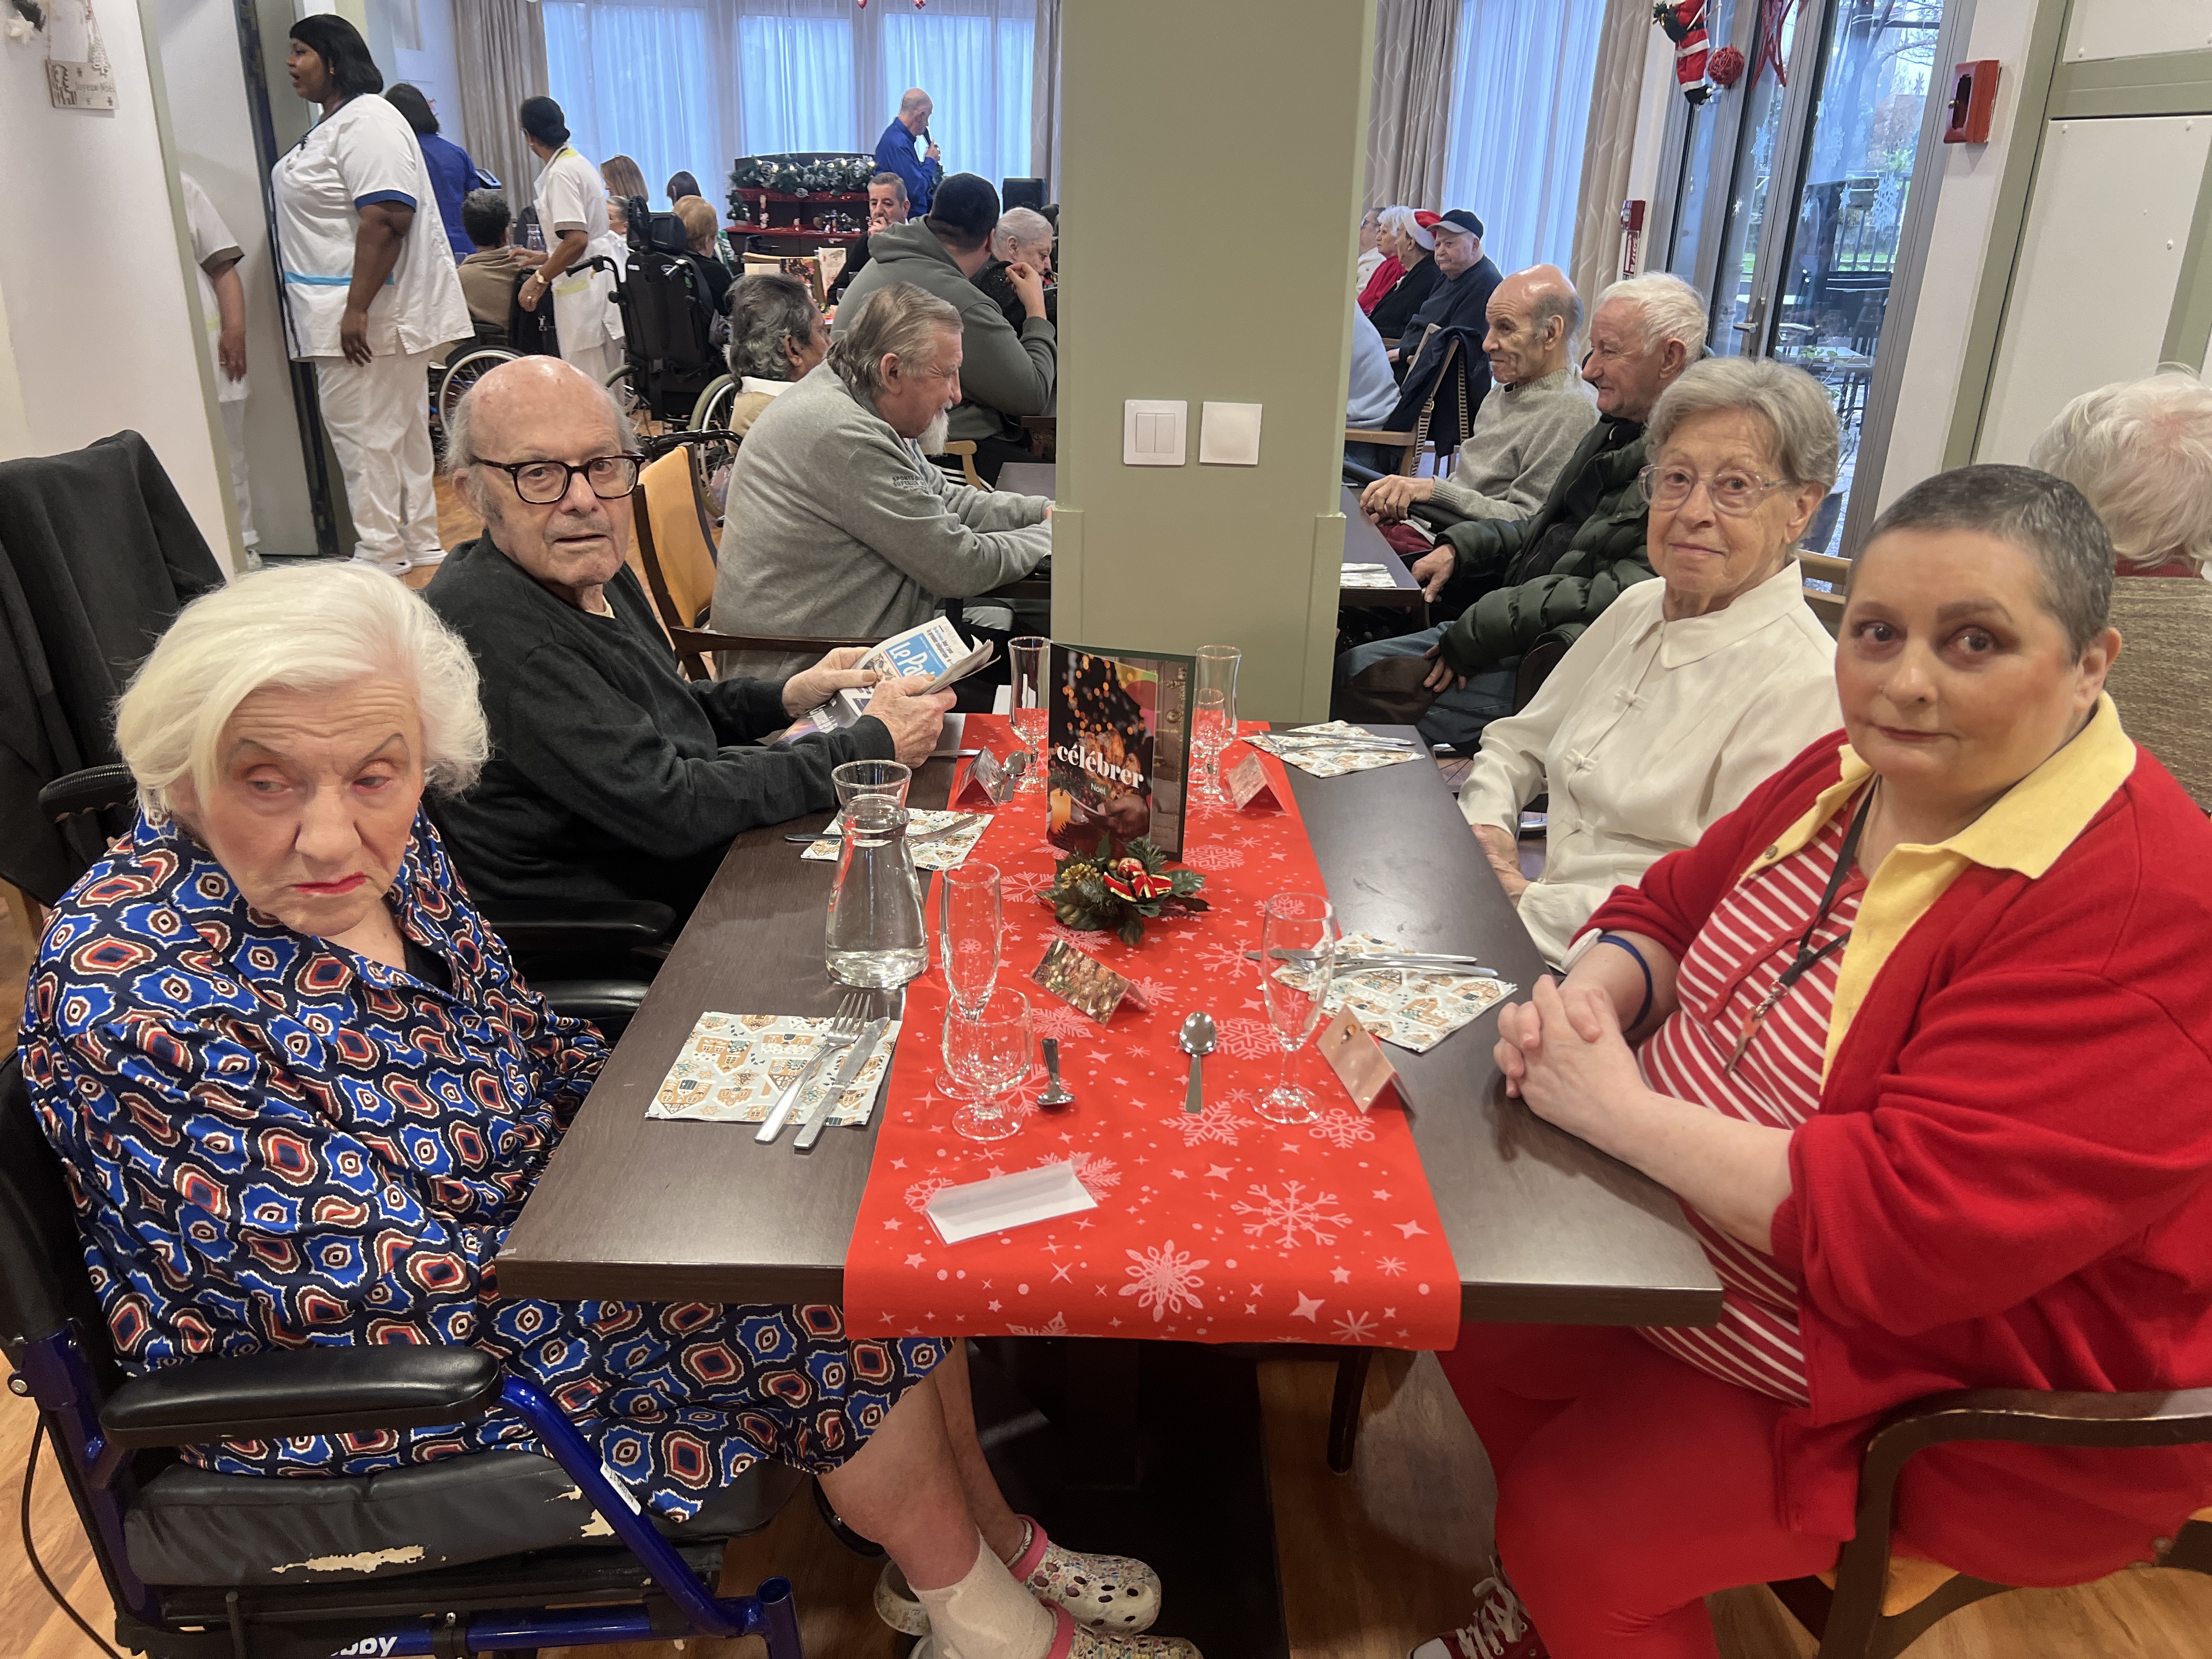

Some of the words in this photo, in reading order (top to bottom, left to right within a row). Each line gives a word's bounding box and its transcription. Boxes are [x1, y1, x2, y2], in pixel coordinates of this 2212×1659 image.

[889, 642, 911, 659] Le
[897, 651, 935, 676] Par
[1057, 744, 1144, 788] célébrer
[1091, 783, 1106, 795] Noël
